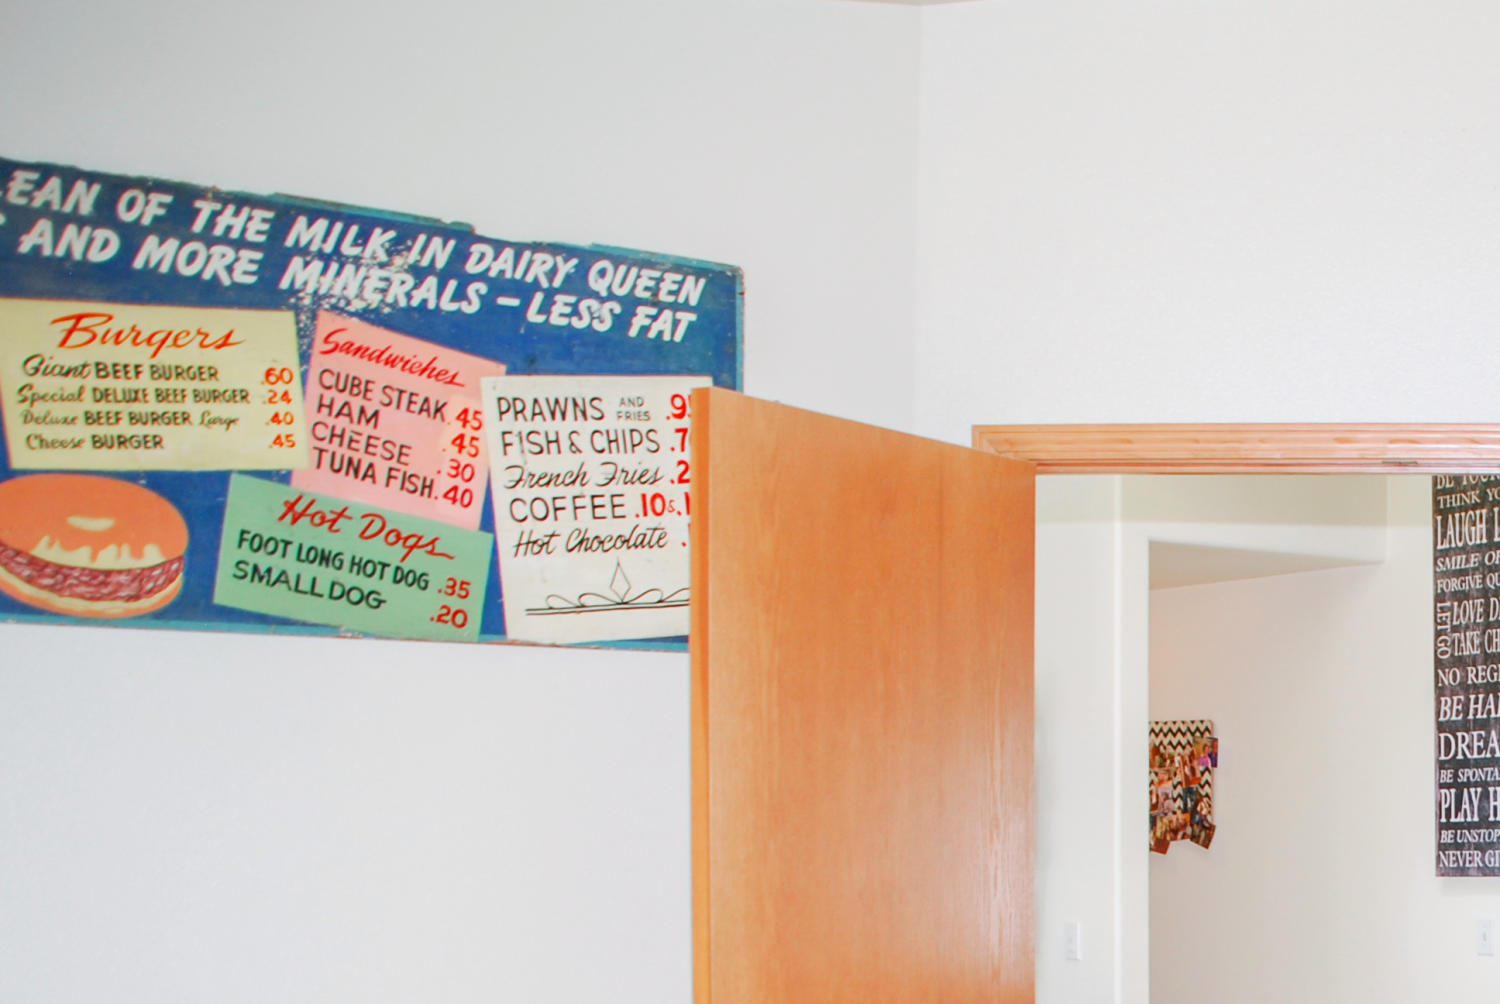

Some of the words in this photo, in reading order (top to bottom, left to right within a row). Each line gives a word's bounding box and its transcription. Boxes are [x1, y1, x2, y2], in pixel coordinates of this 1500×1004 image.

[0, 169, 101, 217] EAN
[116, 189, 173, 226] OF
[191, 200, 276, 242] THE
[284, 215, 397, 262] MILK
[407, 233, 456, 269] IN
[465, 243, 578, 289] DAIRY
[588, 260, 706, 306] QUEEN
[18, 217, 120, 263] AND
[132, 234, 264, 287] MORE
[278, 256, 488, 314] MINERALS
[526, 292, 622, 333] LESS
[628, 305, 697, 343] FAT
[50, 312, 246, 359] Burgers
[22, 353, 90, 379] Giant
[94, 362, 144, 380] BEEF
[150, 364, 219, 381] BURGER
[320, 328, 465, 387] Sandwiches
[17, 383, 84, 408] Special
[92, 388, 149, 403] DELUXE
[154, 388, 188, 404] BEEF
[193, 388, 250, 404] BURGER
[318, 368, 376, 401] CUBE
[379, 384, 448, 423] STEAK
[496, 396, 605, 422] PRAWNS
[618, 397, 644, 407] AND
[666, 394, 691, 420] .9
[21, 410, 78, 426] Deluxe
[84, 410, 123, 426] BEEF
[128, 410, 192, 426] BURGER
[199, 411, 240, 431] Large
[316, 393, 381, 430] HAM
[616, 410, 651, 421] FRIES
[26, 434, 86, 450] Cheese
[91, 434, 164, 449] BURGER
[311, 421, 412, 466] CHEESE
[501, 429, 561, 456] FISH
[568, 431, 582, 454] &
[590, 428, 660, 454] CHIPS
[670, 428, 691, 452] .7
[312, 447, 378, 484] TUNA
[385, 467, 434, 498] FISH
[504, 461, 590, 489] French
[595, 461, 664, 487] Fries
[509, 494, 627, 522] COFFEE
[1437, 490, 1481, 509] THINK
[278, 494, 352, 533] Hot
[359, 513, 455, 562] Dogs
[514, 528, 560, 557] Hot
[565, 524, 668, 553] Chocolate
[1436, 508, 1488, 550] LAUGH
[237, 529, 293, 556] FOOT
[296, 542, 344, 571] LONG
[349, 555, 391, 580] HOT
[392, 565, 429, 591] DOG
[1436, 553, 1480, 572] SMILE
[1437, 574, 1483, 593] FORGIVE
[1437, 601, 1451, 632] LET
[1452, 599, 1484, 626] LOVE
[1437, 635, 1451, 659] GO
[1452, 631, 1480, 656] TAKE
[1437, 667, 1460, 686] NO
[1439, 695, 1464, 721] BE
[1440, 769, 1454, 783] BE
[1440, 787, 1482, 822] PLAY
[1440, 829, 1455, 843] BE
[1439, 850, 1483, 867] NEVER
